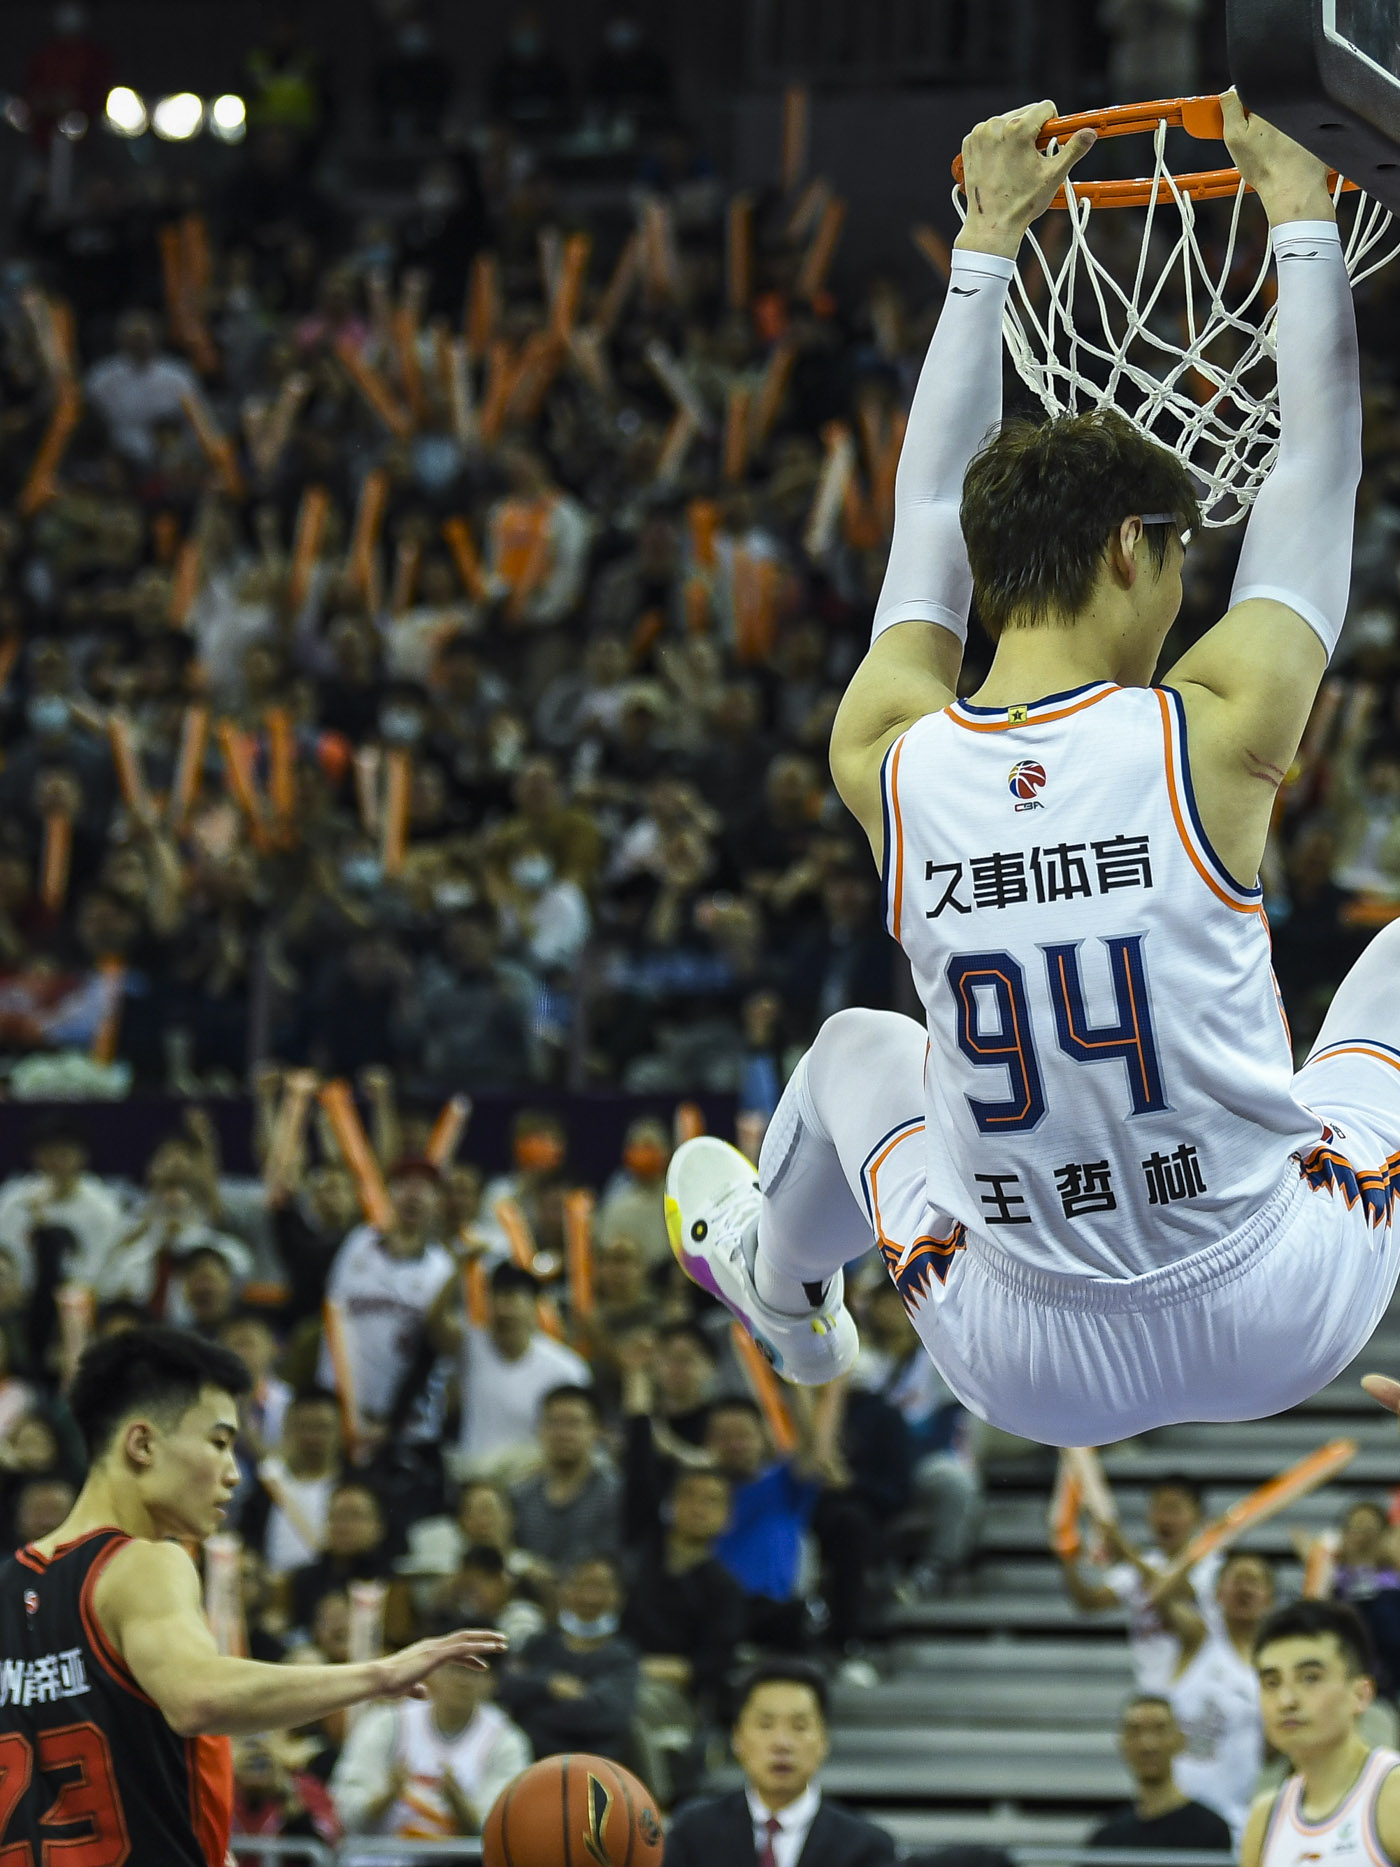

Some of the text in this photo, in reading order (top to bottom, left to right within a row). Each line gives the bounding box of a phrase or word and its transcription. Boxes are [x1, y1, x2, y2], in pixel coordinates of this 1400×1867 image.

[1014, 801, 1045, 812] CBA
[924, 834, 1154, 919] 久事体育
[943, 930, 1176, 1136] 94
[974, 1143, 1207, 1225] 王哲林
